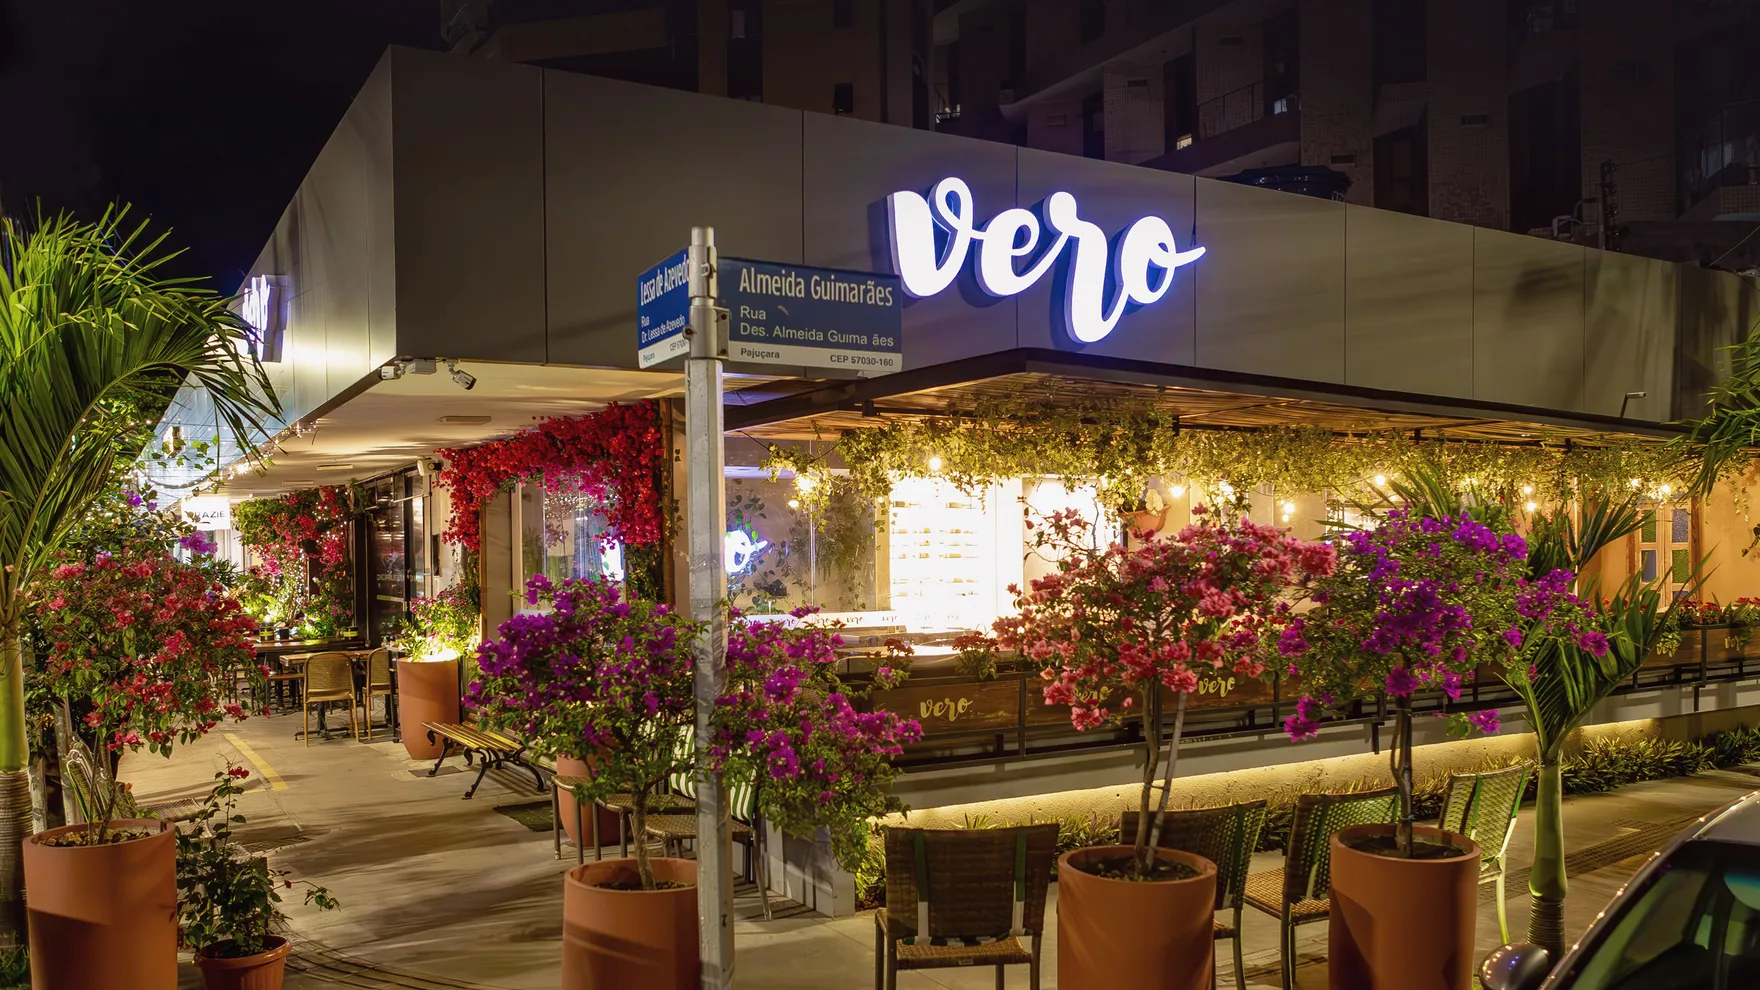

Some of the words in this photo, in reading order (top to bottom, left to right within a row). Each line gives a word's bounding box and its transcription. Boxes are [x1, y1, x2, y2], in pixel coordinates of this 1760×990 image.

[891, 177, 1206, 343] vero
[640, 278, 656, 306] Lessa
[656, 269, 664, 297] de
[739, 267, 805, 298] Almeida
[810, 274, 893, 306] Guimarães
[740, 305, 767, 320] Rua
[740, 322, 770, 337] Des.
[773, 325, 824, 341] Almeida
[828, 330, 894, 347] Guimaães
[740, 348, 780, 360] Pajuçara
[830, 354, 849, 364] CEP
[851, 356, 894, 367] 57030-160
[1198, 676, 1236, 698] vero
[920, 697, 974, 722] vero
